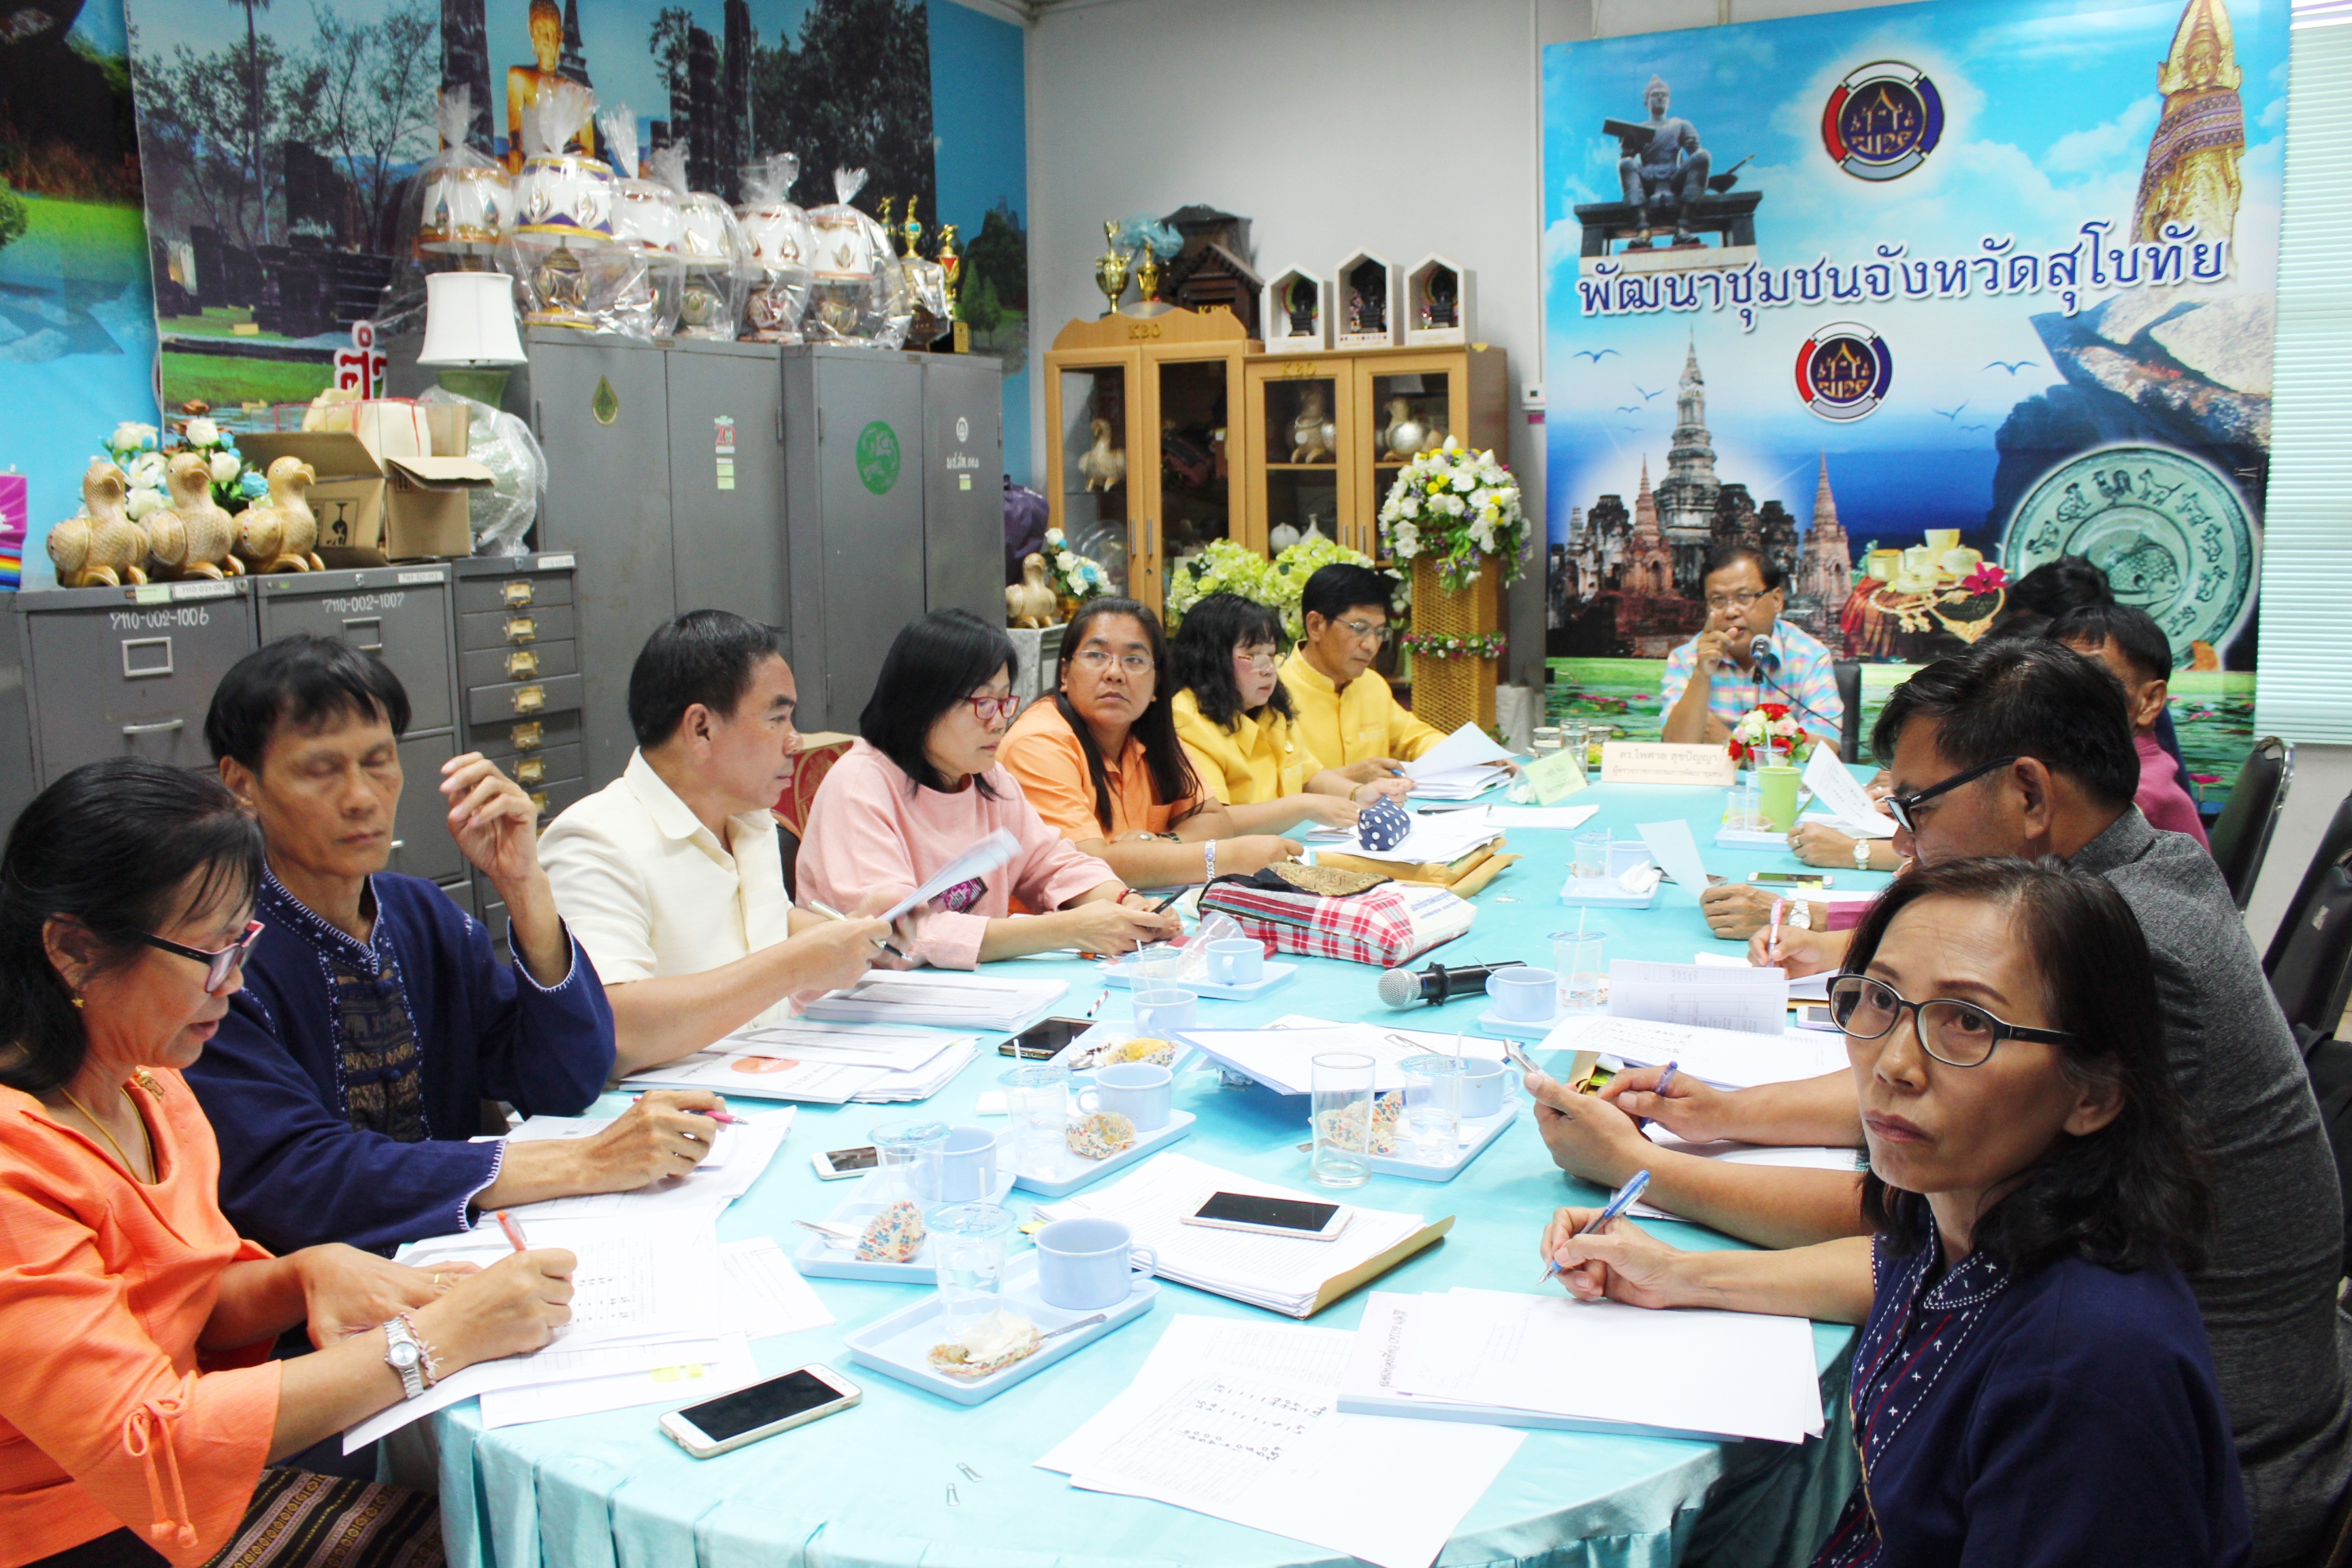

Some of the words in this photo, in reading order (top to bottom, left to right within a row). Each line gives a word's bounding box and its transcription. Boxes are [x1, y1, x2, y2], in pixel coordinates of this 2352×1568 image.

[1279, 361, 1317, 376] KBO
[322, 592, 406, 613] 7110-002-1007
[110, 606, 209, 630] 7110-002-1006
[1388, 1325, 1402, 1345] OTOP
[1308, 1406, 1328, 1419] 146
